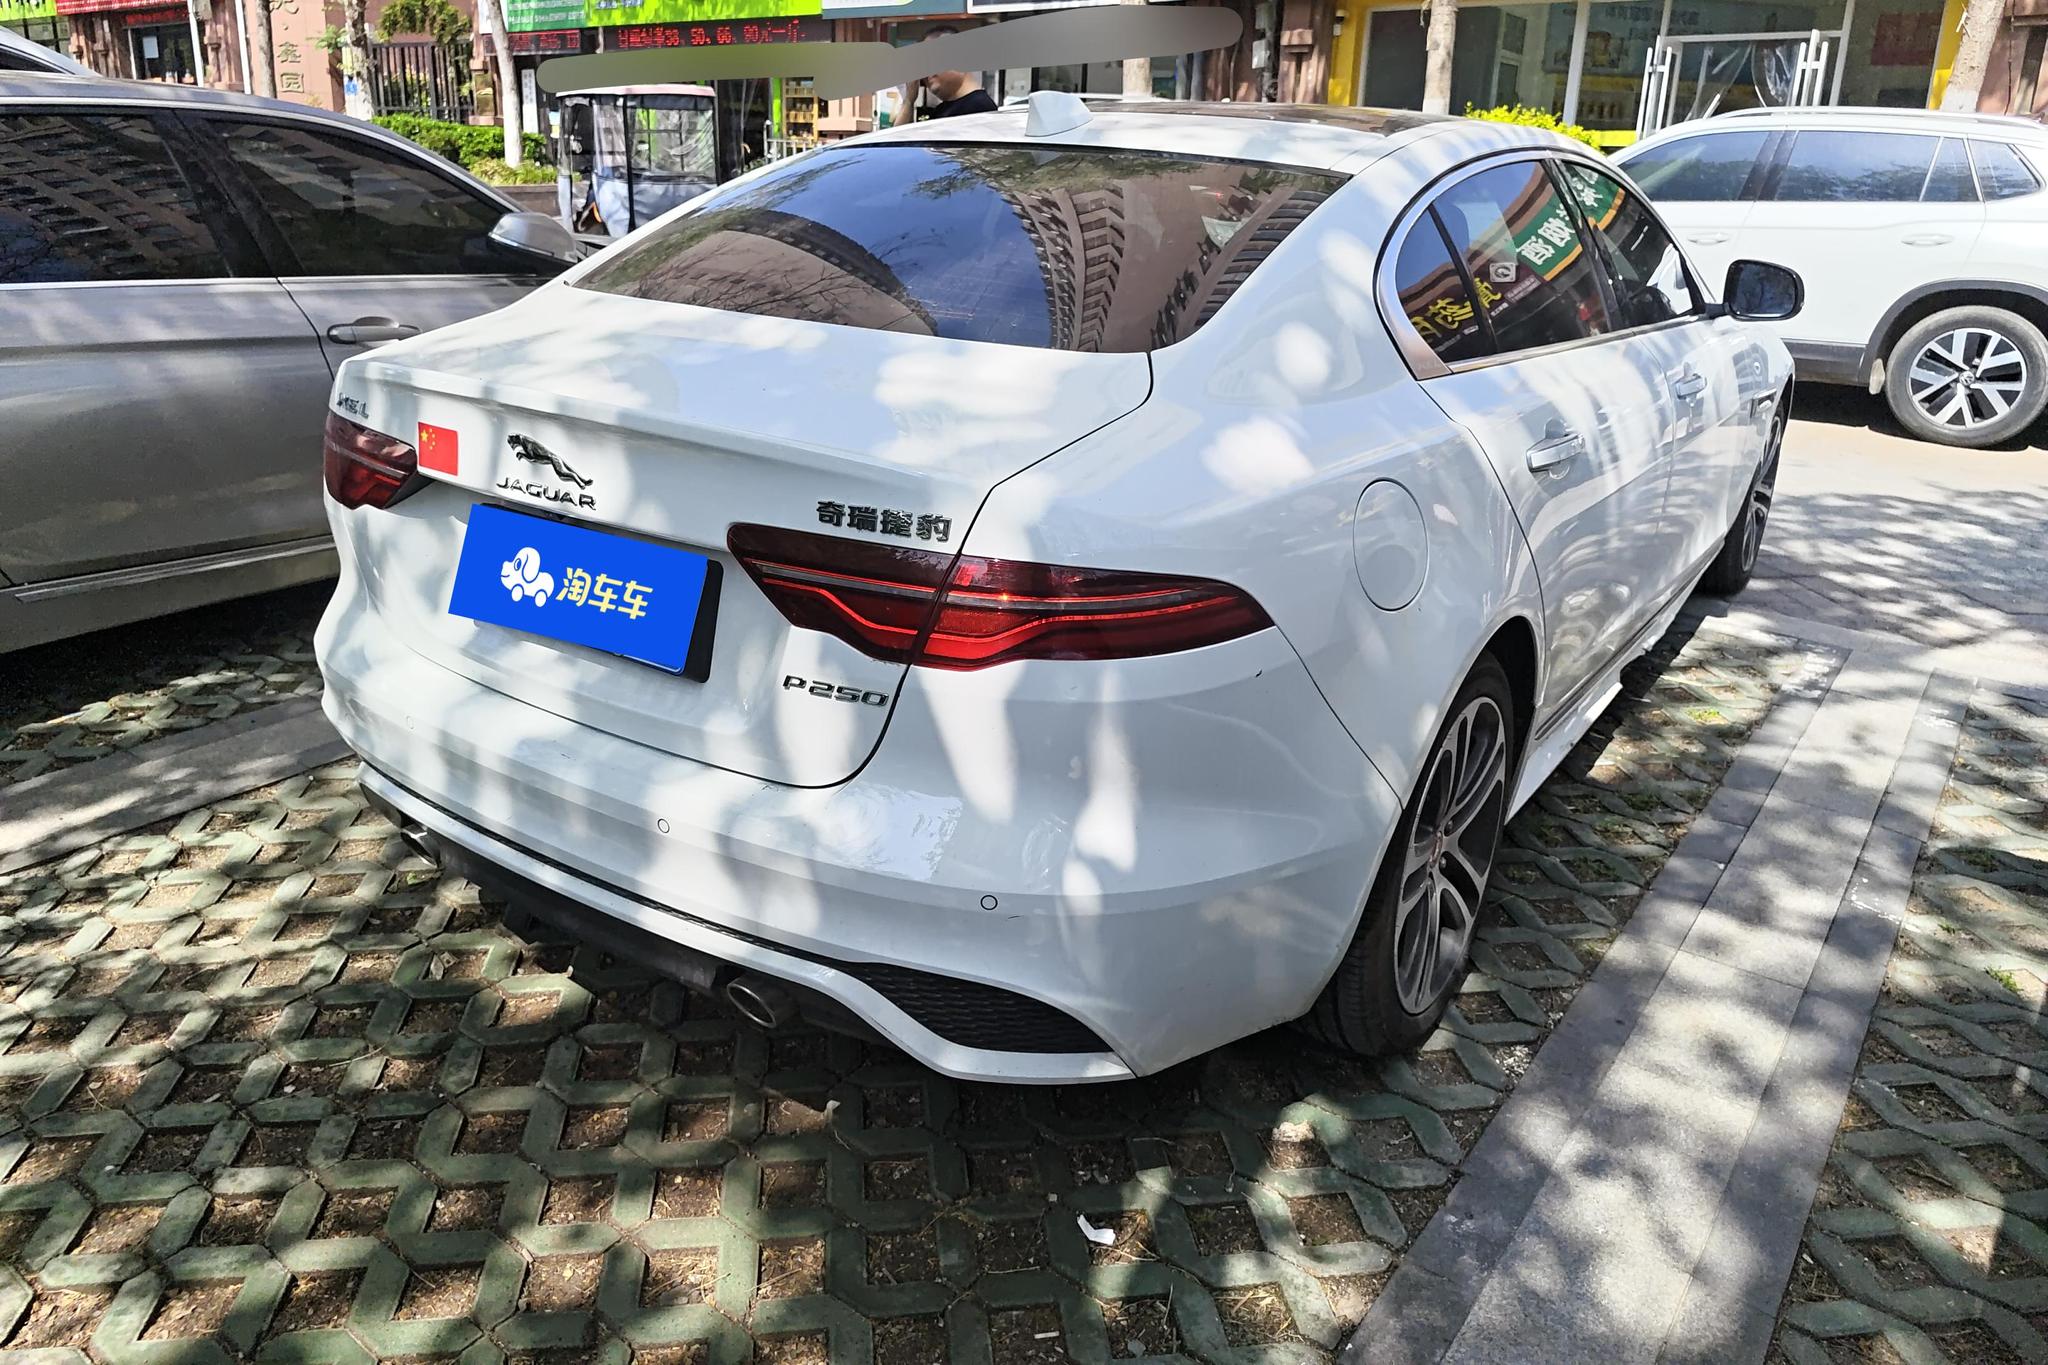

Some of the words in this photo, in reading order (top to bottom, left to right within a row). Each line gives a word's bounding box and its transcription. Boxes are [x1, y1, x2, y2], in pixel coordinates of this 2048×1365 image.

[496, 477, 596, 510] JAGUAR
[816, 501, 952, 542] 奇瑞捷豹
[782, 675, 889, 706] P250
